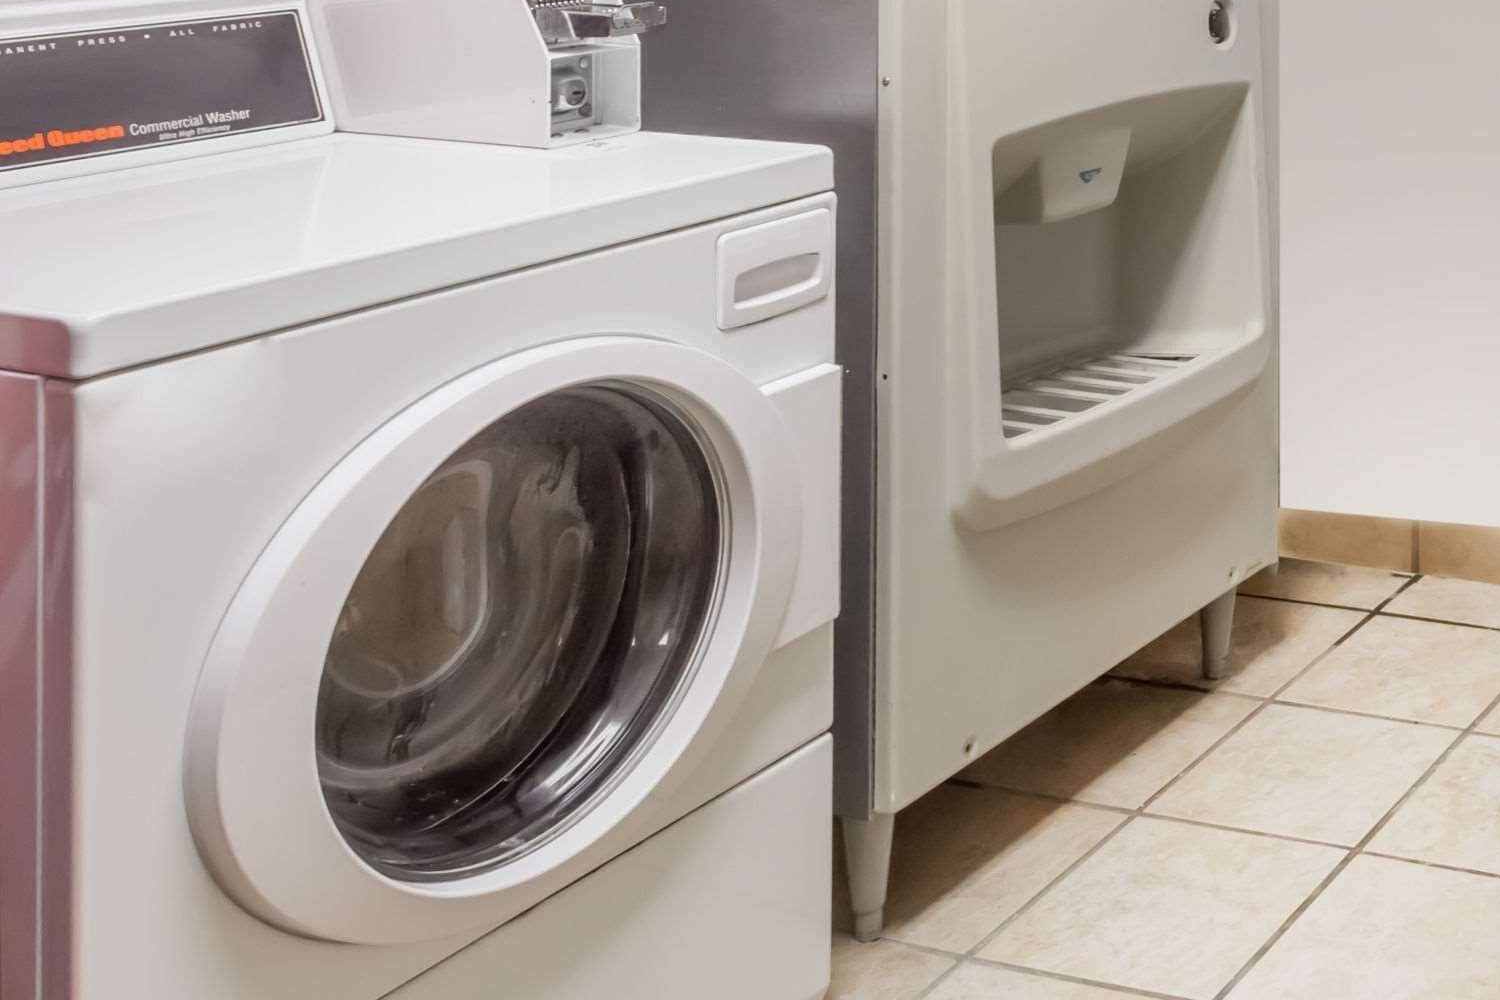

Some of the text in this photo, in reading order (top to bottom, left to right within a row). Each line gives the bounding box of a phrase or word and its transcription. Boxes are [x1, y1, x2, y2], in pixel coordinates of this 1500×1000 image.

[0, 21, 262, 56] ANENT PRESS ALL FABRIC
[129, 114, 204, 136] Commercial
[205, 109, 251, 125] Washer
